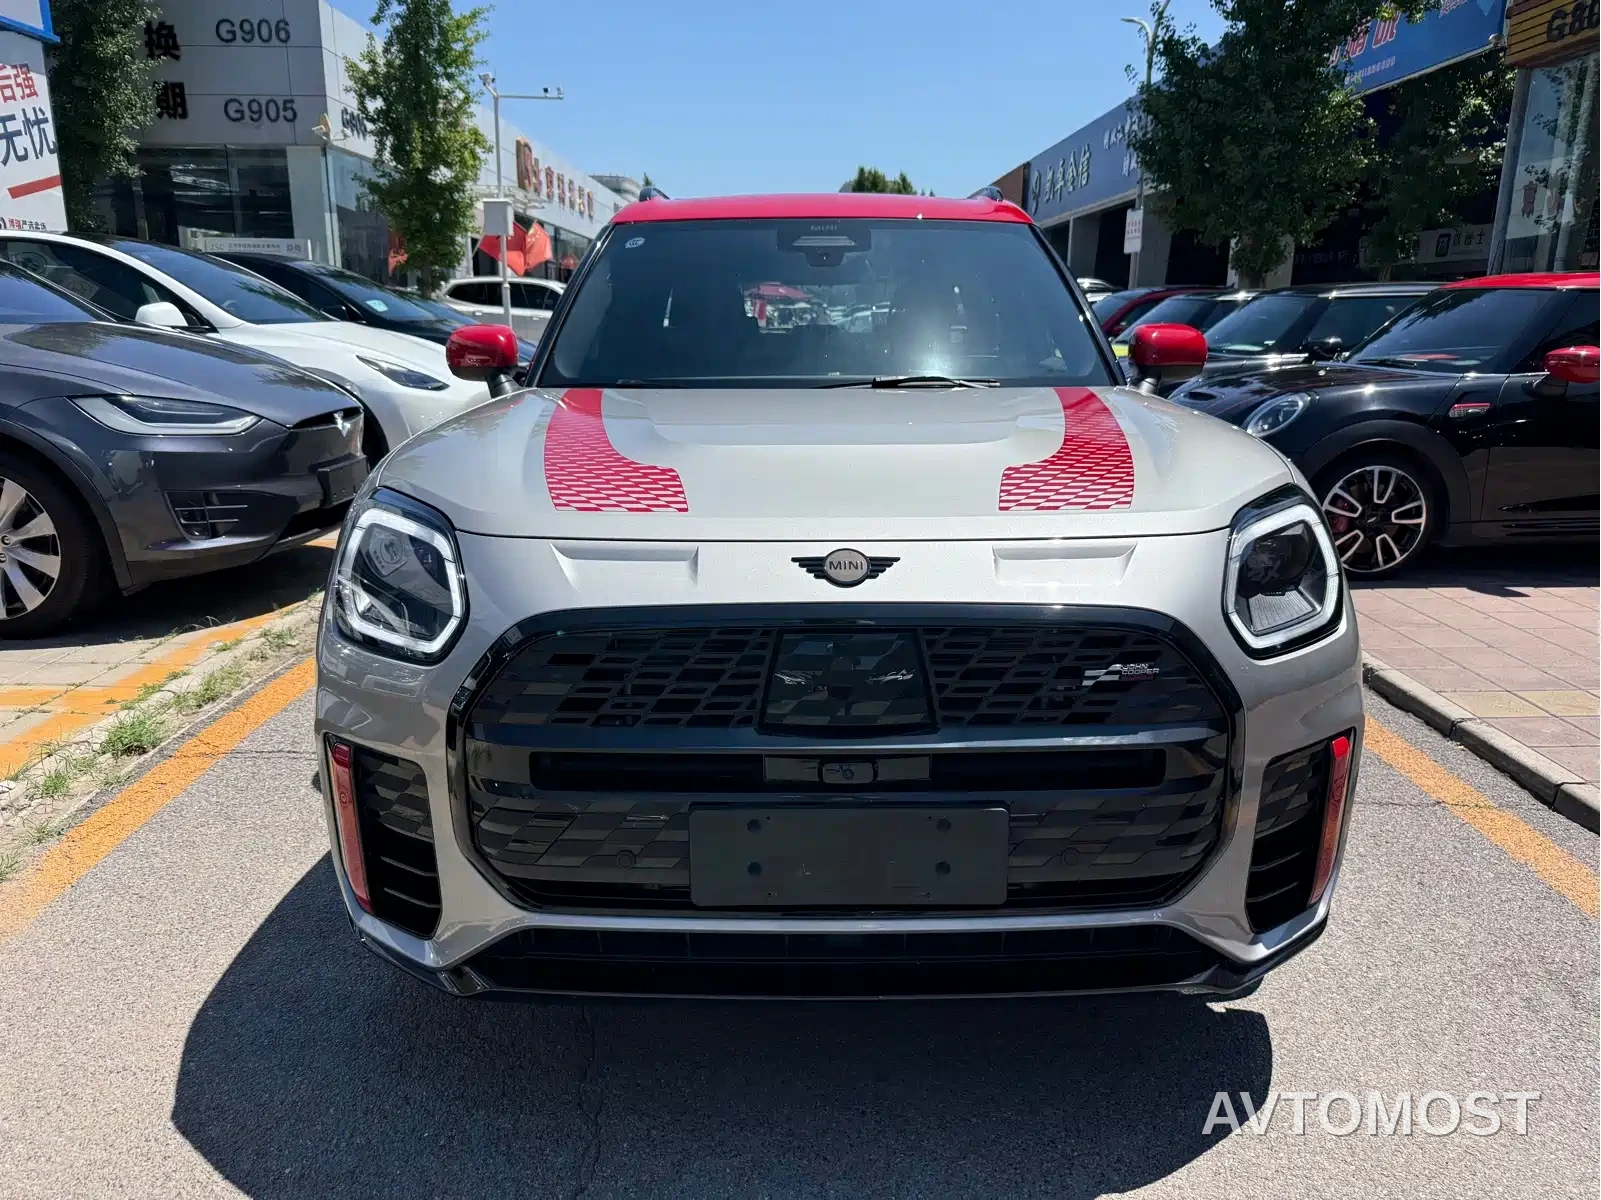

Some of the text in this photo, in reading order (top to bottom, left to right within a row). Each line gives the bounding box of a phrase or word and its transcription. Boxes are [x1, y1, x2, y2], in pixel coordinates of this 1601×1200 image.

[215, 18, 291, 43] G906
[223, 98, 298, 123] G905
[0, 106, 57, 167] 无忧
[828, 560, 864, 571] MINI
